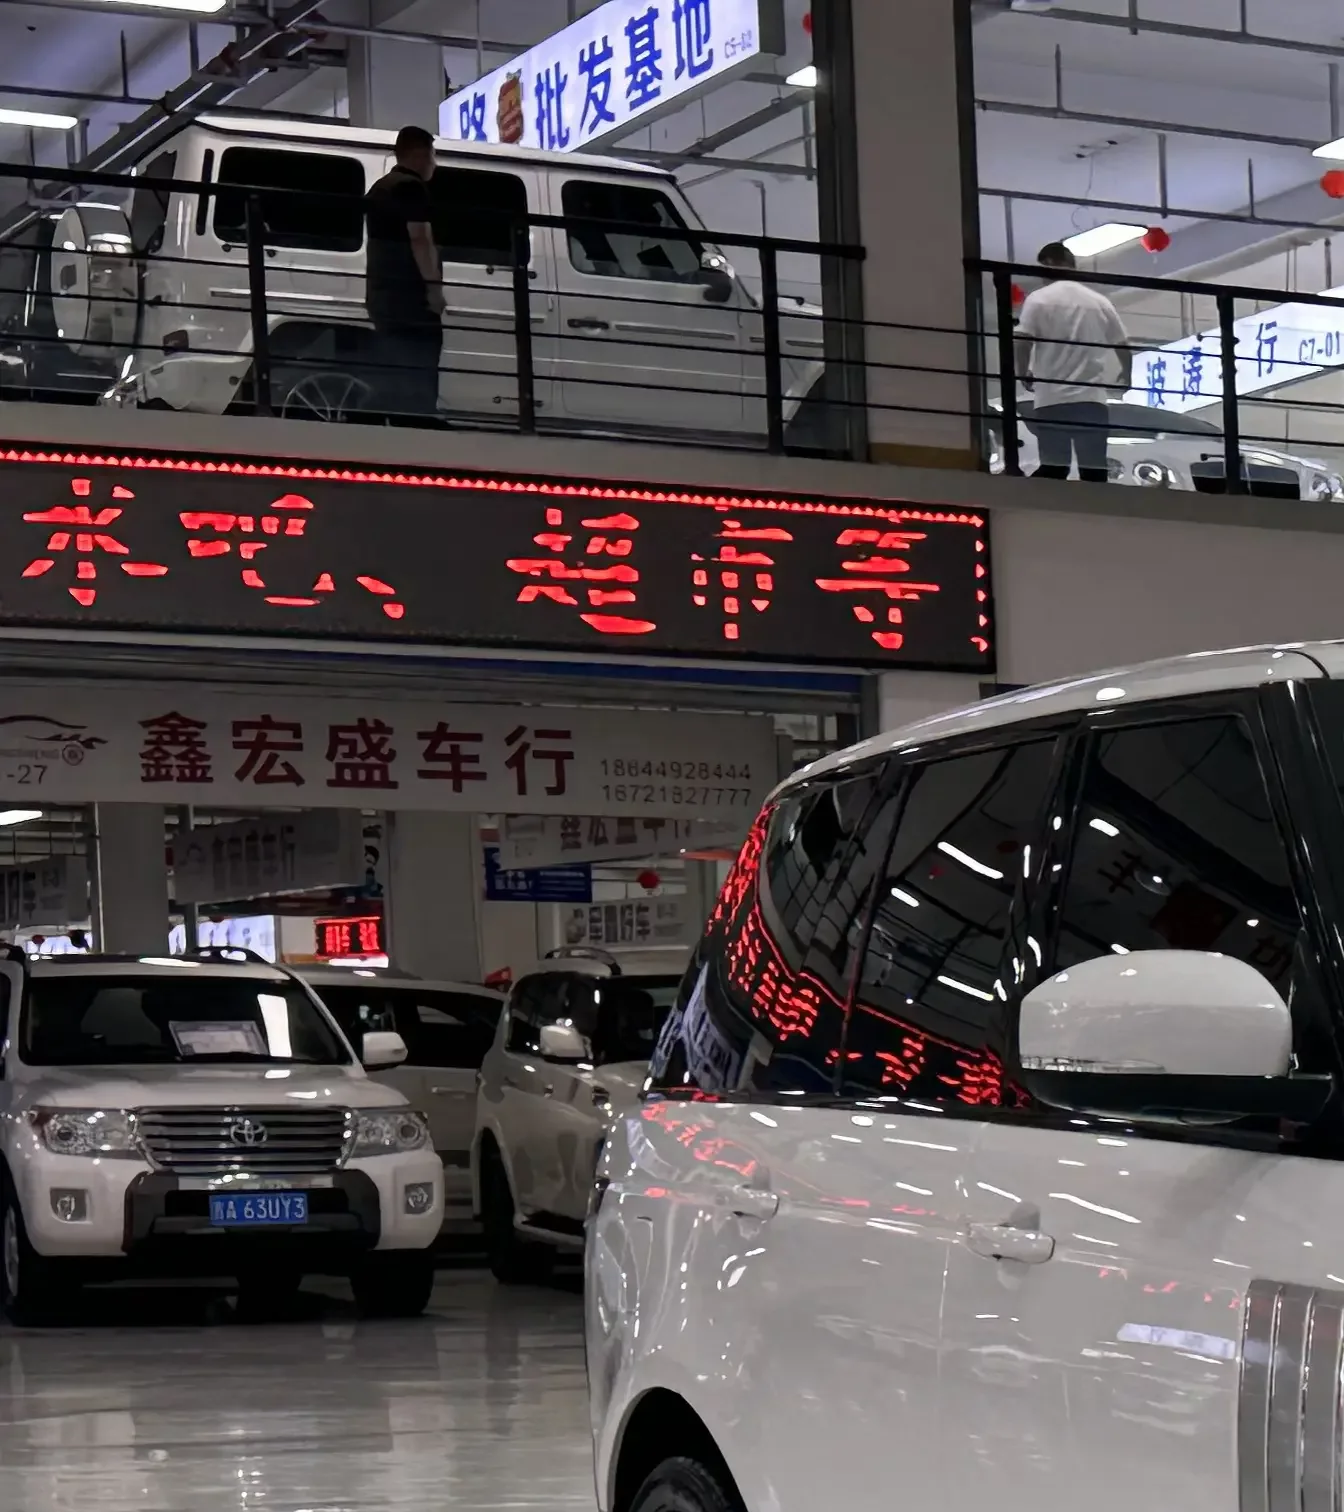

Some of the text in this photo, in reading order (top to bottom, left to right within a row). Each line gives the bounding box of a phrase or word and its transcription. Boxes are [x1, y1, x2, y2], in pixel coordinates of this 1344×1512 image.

[459, 0, 714, 151] 路批发基地
[1298, 330, 1341, 363] C7-01
[138, 711, 575, 796] 鑫宏盛车行
